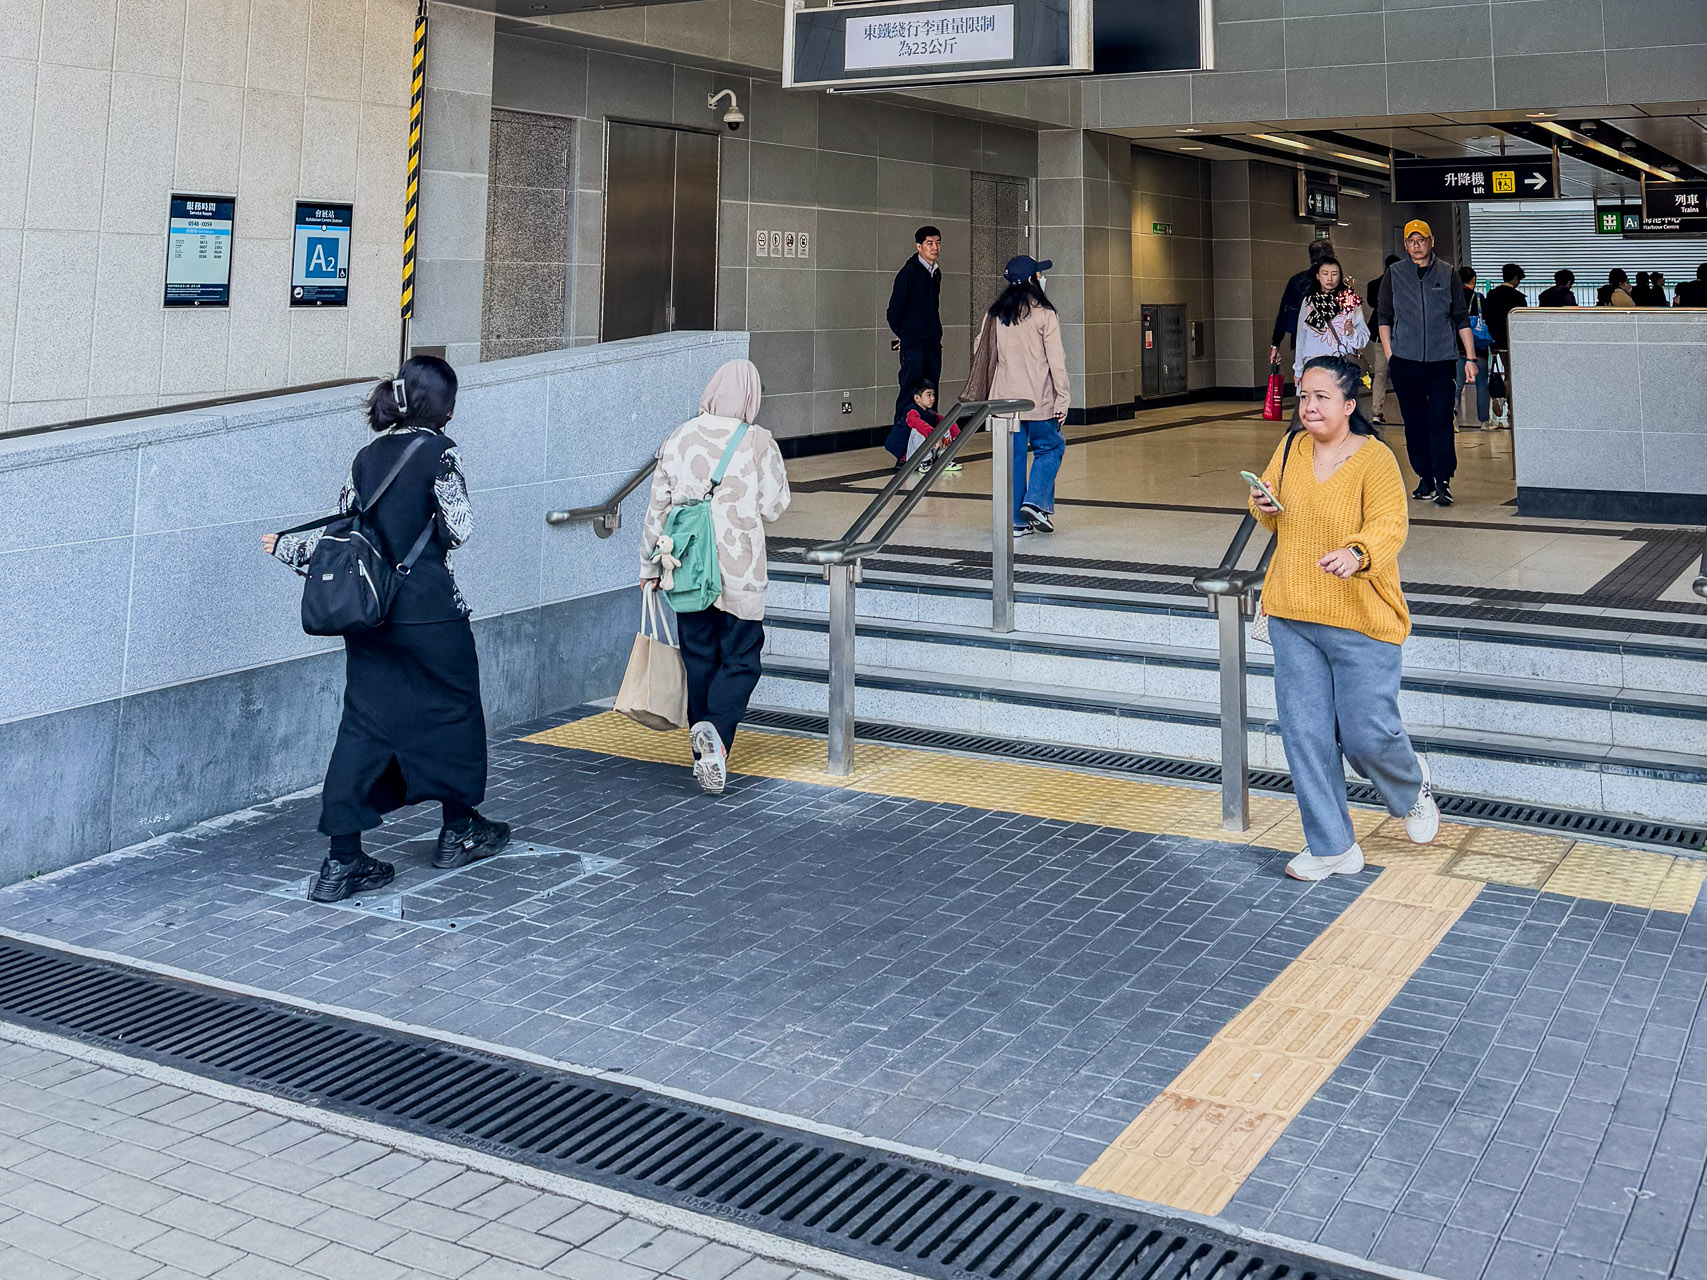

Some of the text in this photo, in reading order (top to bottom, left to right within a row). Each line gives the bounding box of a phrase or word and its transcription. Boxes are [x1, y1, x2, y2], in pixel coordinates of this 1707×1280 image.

[863, 14, 995, 41] 東鐵綫行李重量限制
[898, 38, 958, 57] 為23公斤
[1444, 171, 1485, 186] 升降機
[1473, 186, 1485, 194] Lift
[1674, 193, 1699, 206] 列車
[308, 243, 335, 272] A2
